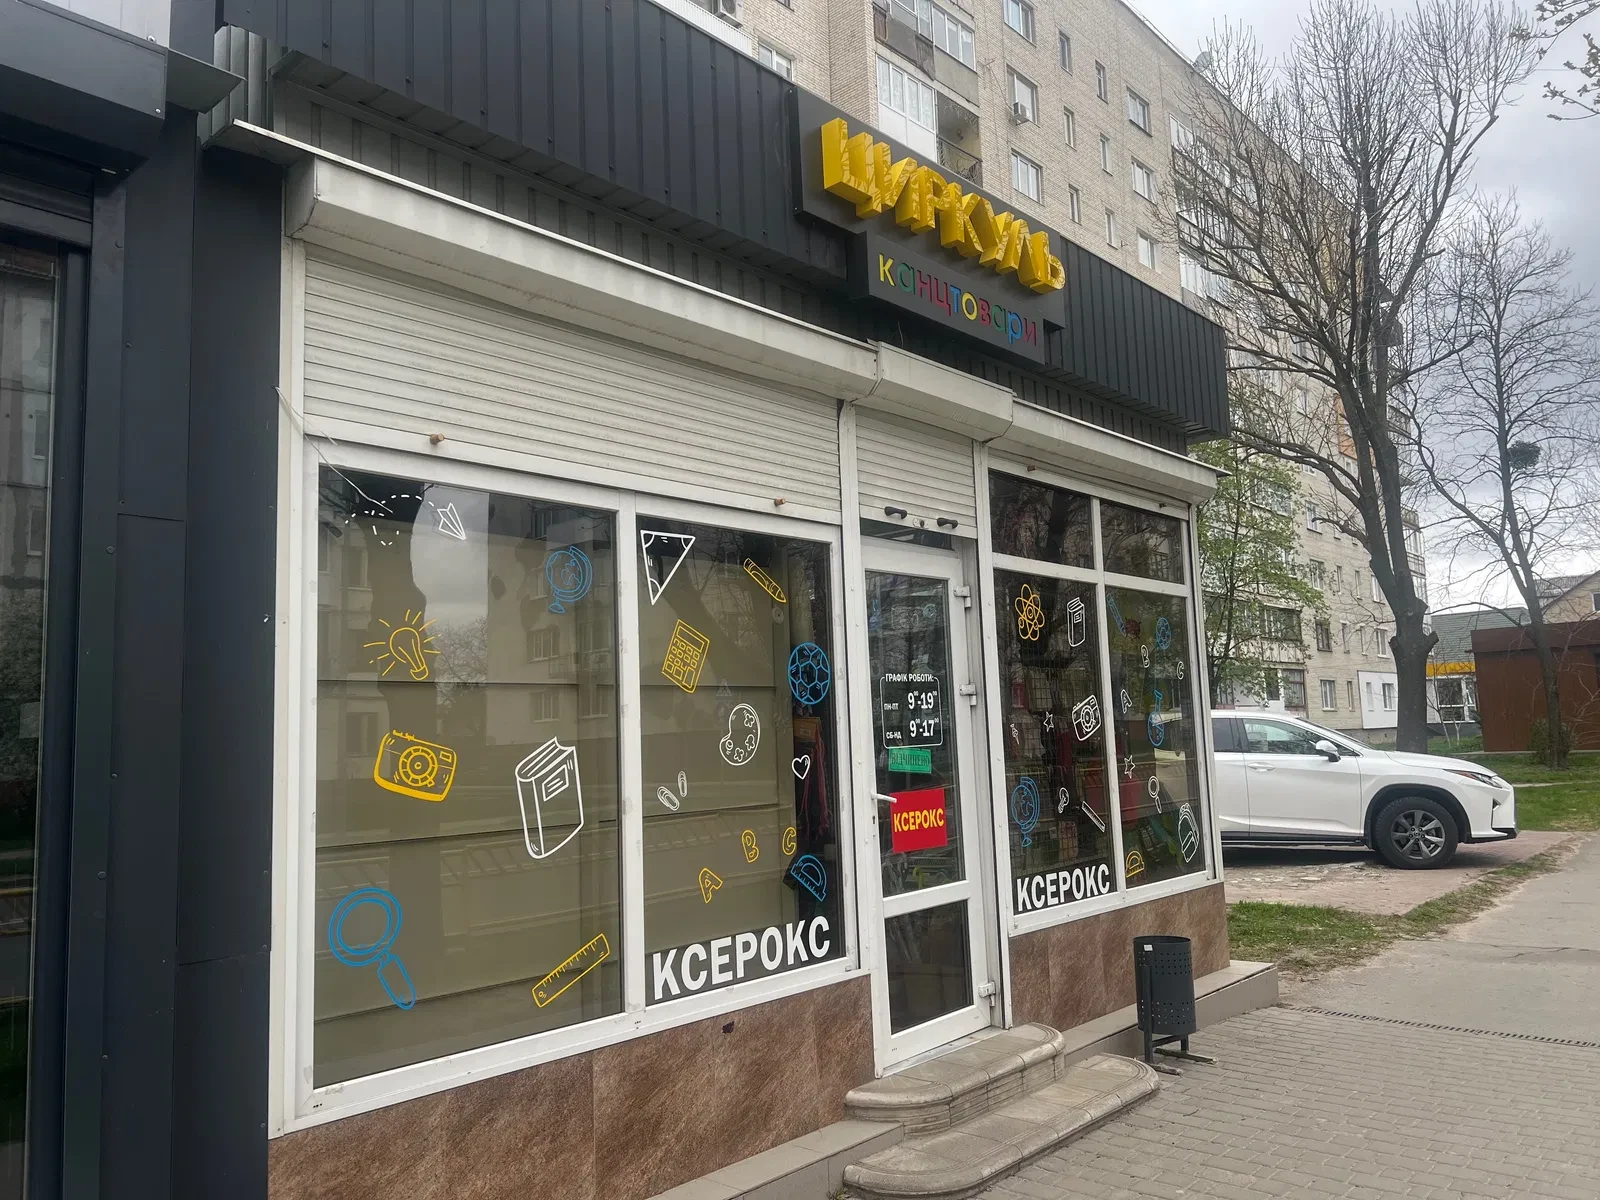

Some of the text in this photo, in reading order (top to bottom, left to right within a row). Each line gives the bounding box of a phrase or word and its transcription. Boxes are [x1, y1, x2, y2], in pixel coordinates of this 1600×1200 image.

[821, 117, 1066, 295] ЦИРКУЛЬ
[878, 253, 1037, 346] канцтовари
[885, 673, 935, 682] ГРАФІК РОБОТИ:
[893, 808, 945, 833] КСЕРОКС
[1016, 863, 1110, 912] КСЕРОКС
[652, 915, 831, 1000] КСЕРОКС
